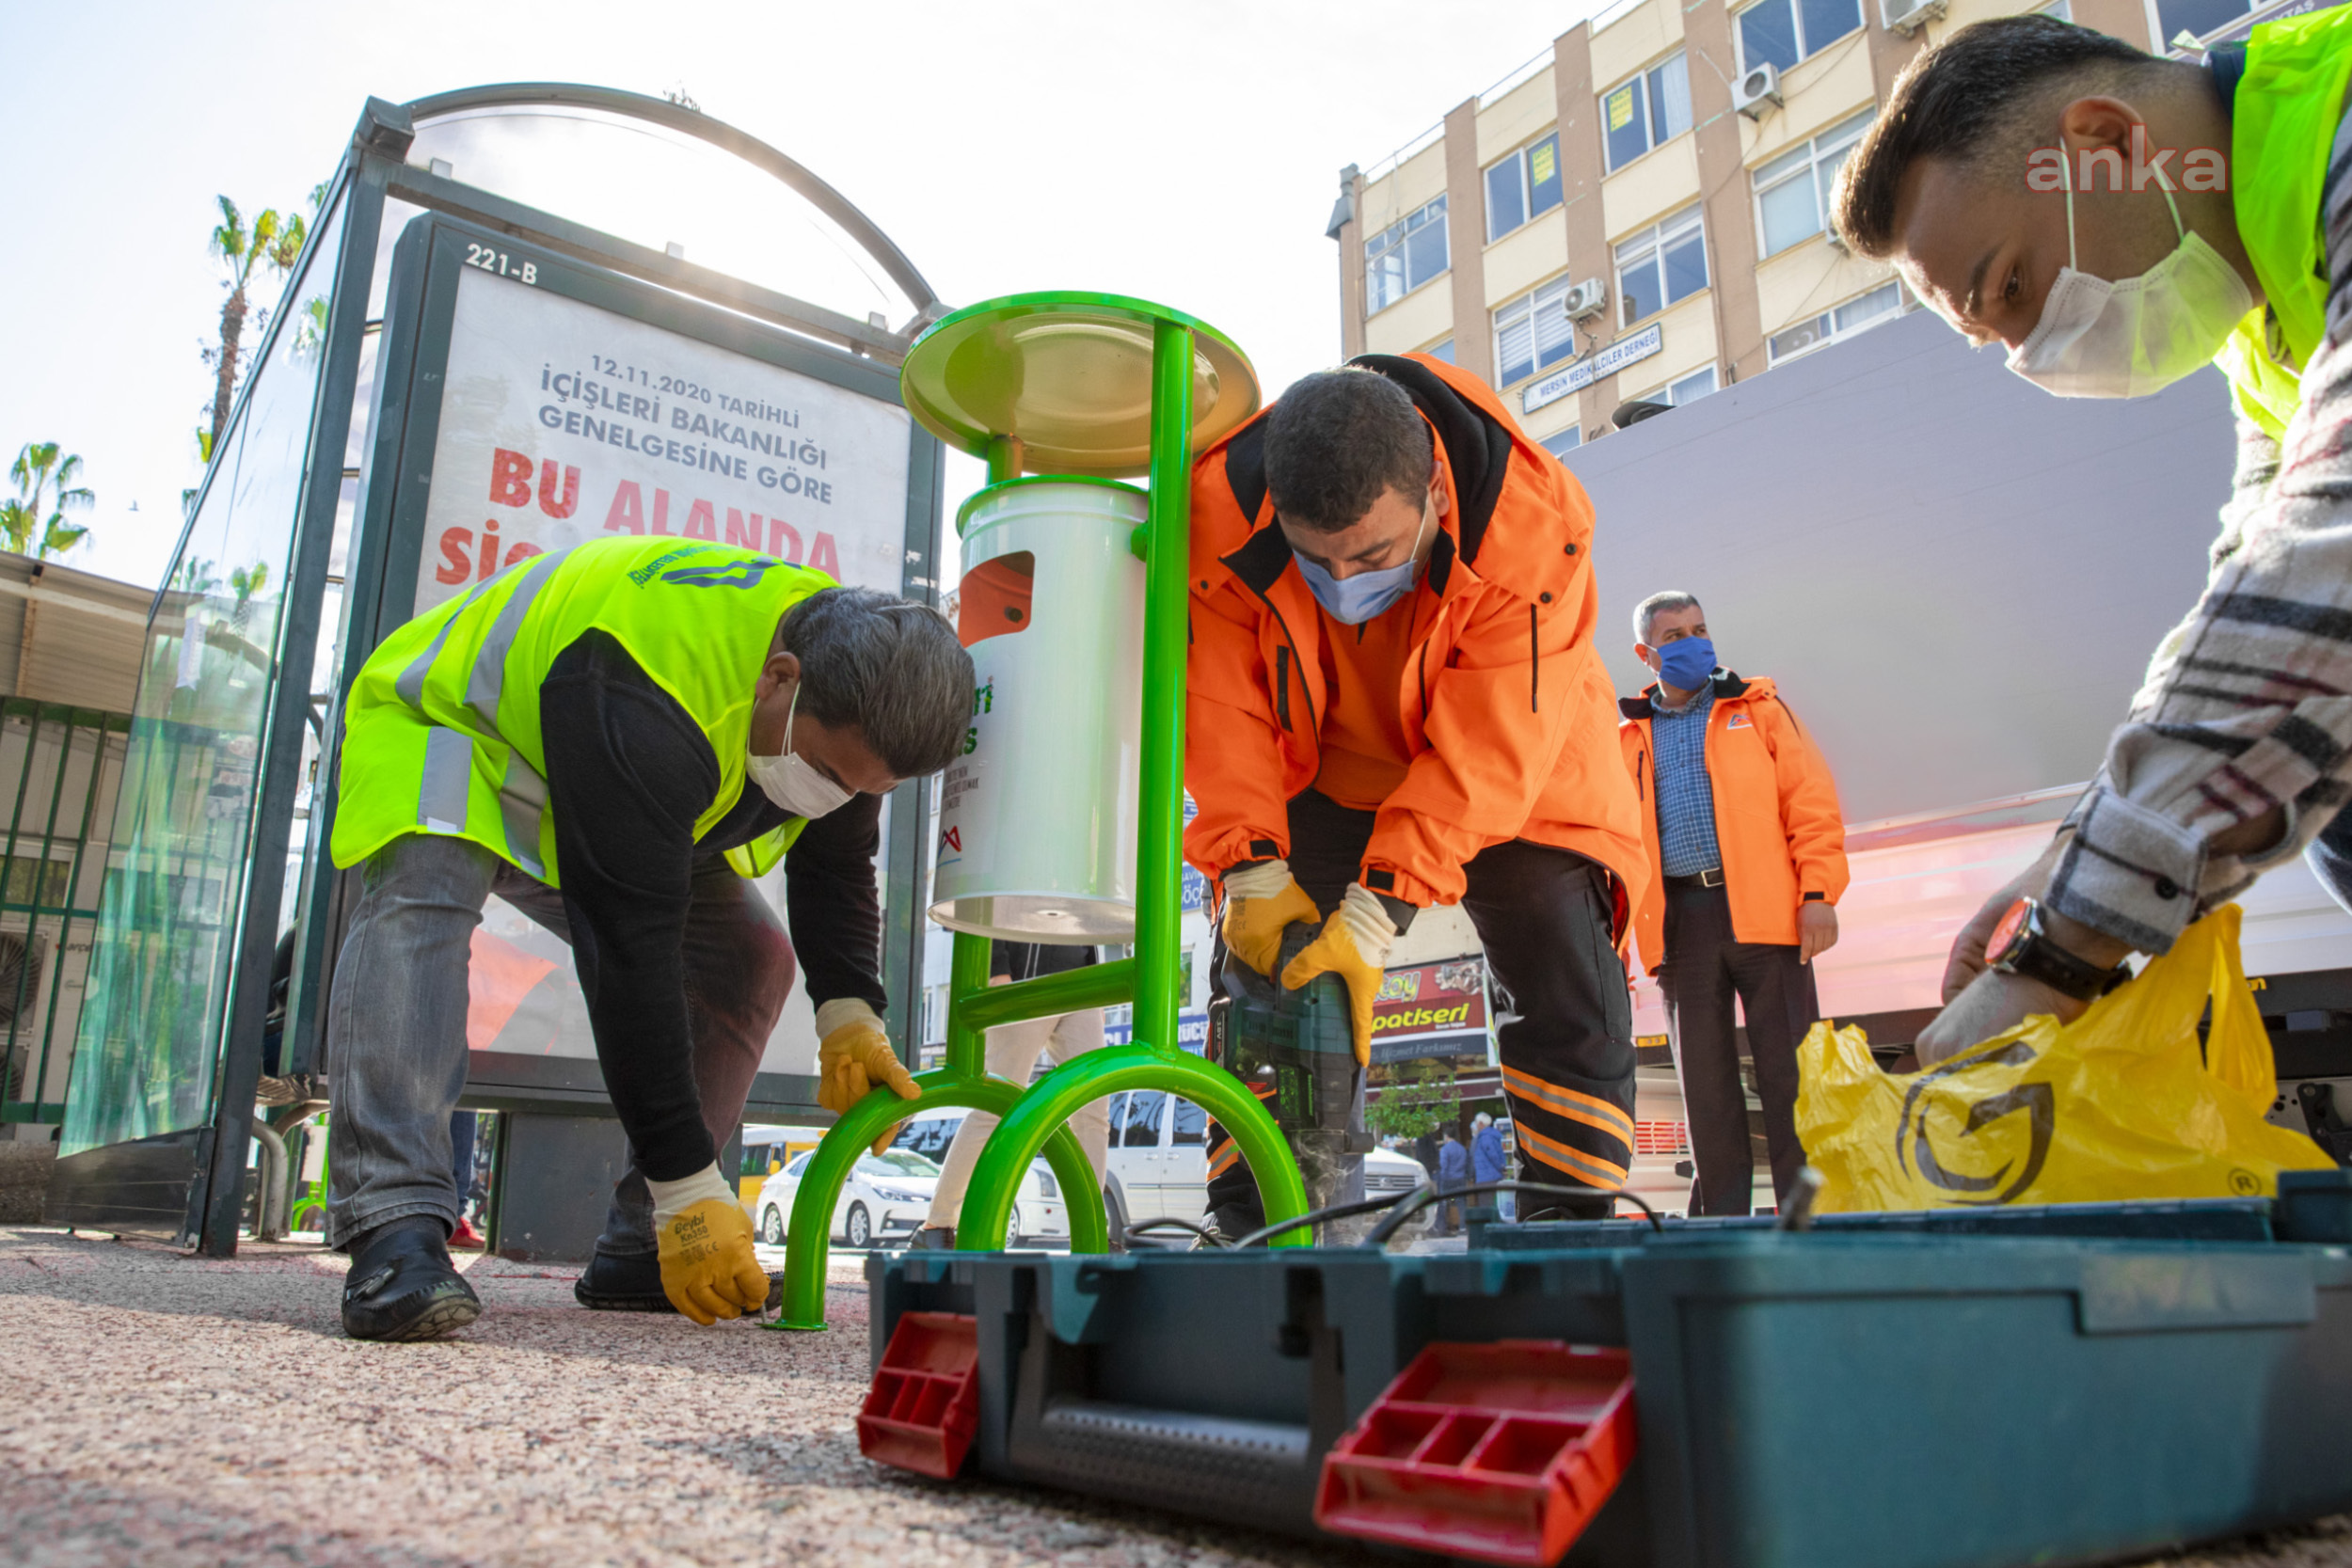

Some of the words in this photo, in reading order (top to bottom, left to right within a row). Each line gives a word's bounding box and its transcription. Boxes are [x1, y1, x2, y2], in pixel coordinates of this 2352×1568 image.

[465, 243, 537, 285] 221-B
[541, 362, 660, 423] İÇİŞLERİ
[670, 406, 826, 470] BAKANLIĞI
[591, 355, 712, 404] 12.11.2020
[717, 393, 800, 429] TARİHLİ
[1539, 376, 1567, 397] MERSİN
[538, 404, 748, 481] GENELGESİNE
[755, 465, 833, 505] GÖRE
[488, 447, 581, 519] BU
[603, 478, 843, 585] ALANDA
